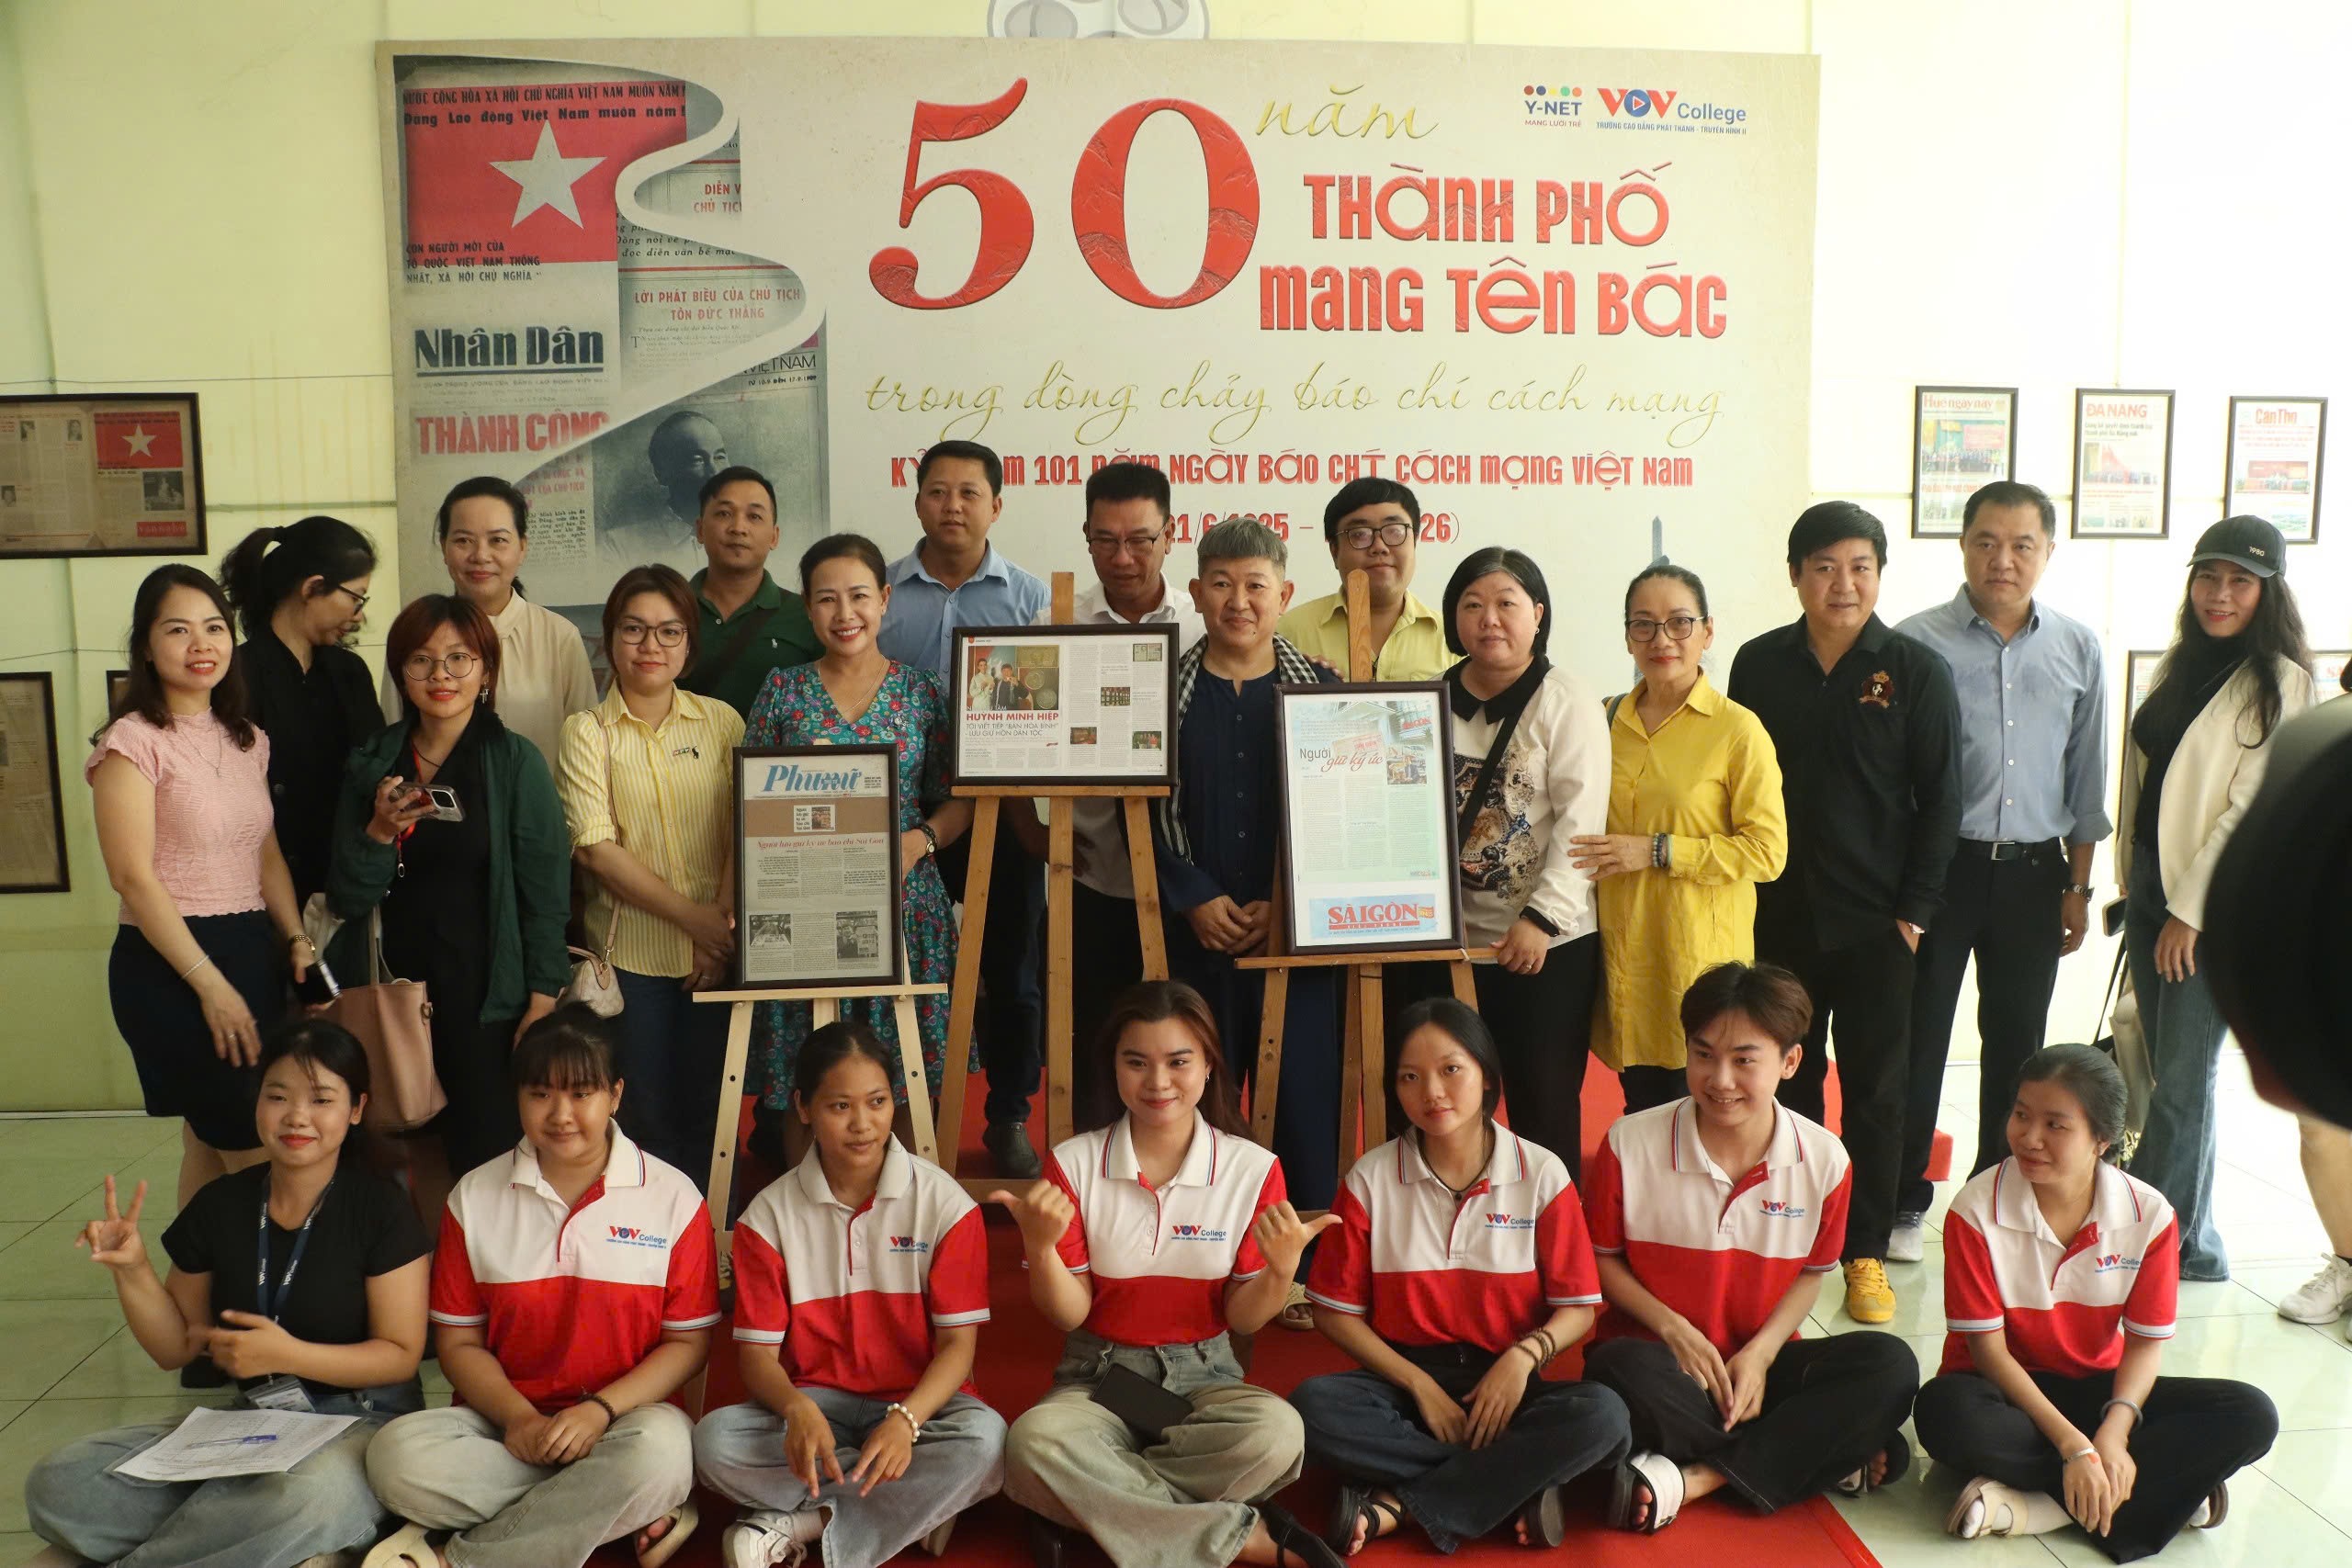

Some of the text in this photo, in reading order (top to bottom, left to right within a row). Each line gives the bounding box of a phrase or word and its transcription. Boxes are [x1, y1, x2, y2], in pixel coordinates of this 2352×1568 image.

[603, 85, 624, 99] NAM
[448, 111, 471, 124] Lao
[559, 107, 589, 120] Nam
[1255, 84, 1439, 140] năm
[1524, 100, 1582, 116] Y-NET
[1597, 87, 1747, 124] VOV College
[868, 77, 1260, 310] 50
[1303, 162, 1672, 247] THÀNH PHỐ
[482, 256, 503, 266] NAM
[659, 288, 686, 303] PHÁT
[723, 286, 744, 301] CỦA
[750, 285, 771, 300] CHỦ
[776, 288, 800, 302] TỊCH
[1260, 255, 1727, 339] MANG TÊN BÁC
[414, 328, 517, 368] Nhân
[526, 325, 604, 366] Dân
[865, 359, 1724, 449] trong dòng chảy báo chí cách mạng
[414, 411, 520, 455] THÀNH
[1035, 455, 1082, 486] 101
[1170, 448, 1248, 485] NGÀY
[1259, 447, 1319, 485] BÁO
[1395, 449, 1470, 485] CÁCH
[1480, 455, 1563, 491] MẠNG
[1572, 450, 1634, 491] VIỆT
[1643, 457, 1693, 487] NAM
[2249, 546, 2266, 557] 1980
[967, 710, 1059, 721] HUỲNH MINH HIỆP
[1299, 748, 1331, 761] Người
[609, 1225, 640, 1239] VOV
[639, 1234, 667, 1245] College
[1172, 1224, 1227, 1238] VOV College
